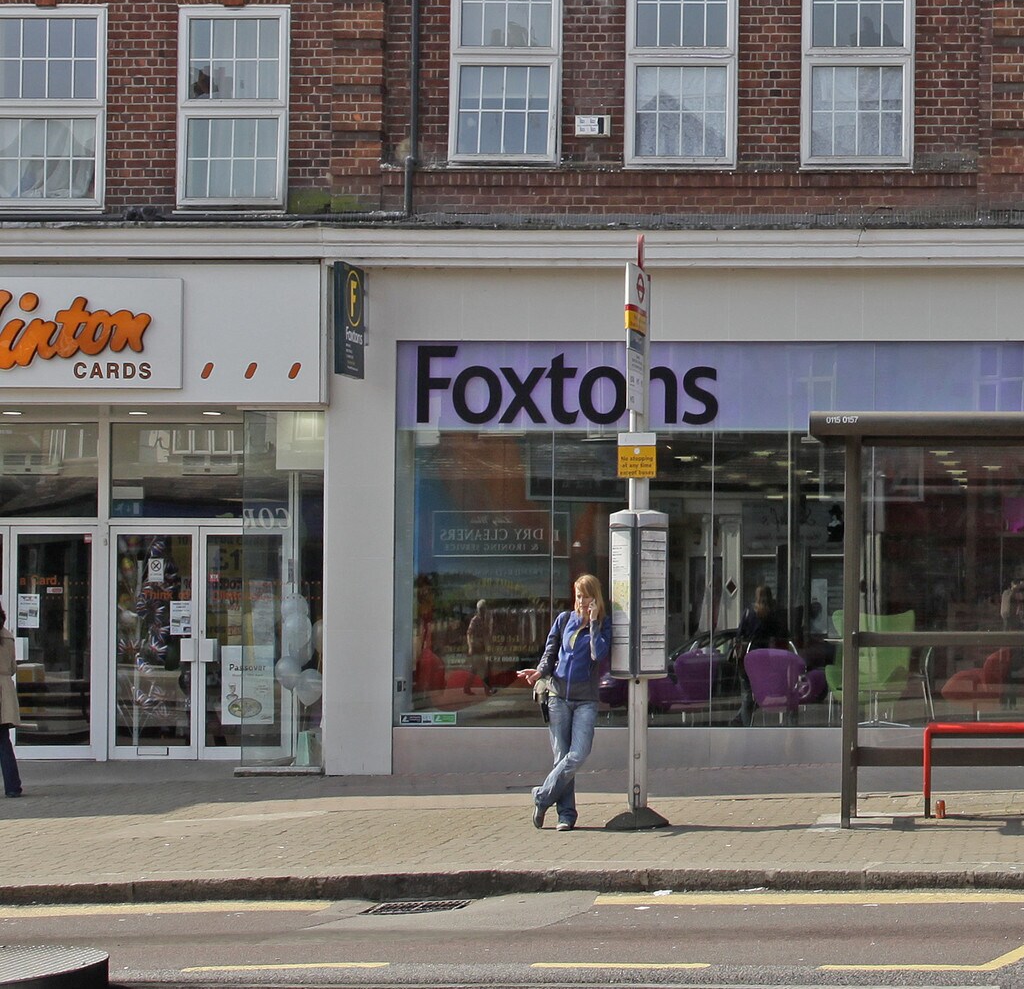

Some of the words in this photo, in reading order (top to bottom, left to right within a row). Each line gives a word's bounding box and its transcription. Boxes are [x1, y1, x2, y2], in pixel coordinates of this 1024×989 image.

[73, 362, 152, 380] CARDS
[416, 345, 719, 425] Foxtons
[826, 416, 841, 424] 0115
[842, 416, 859, 424] 0157
[229, 663, 266, 671] Passover
